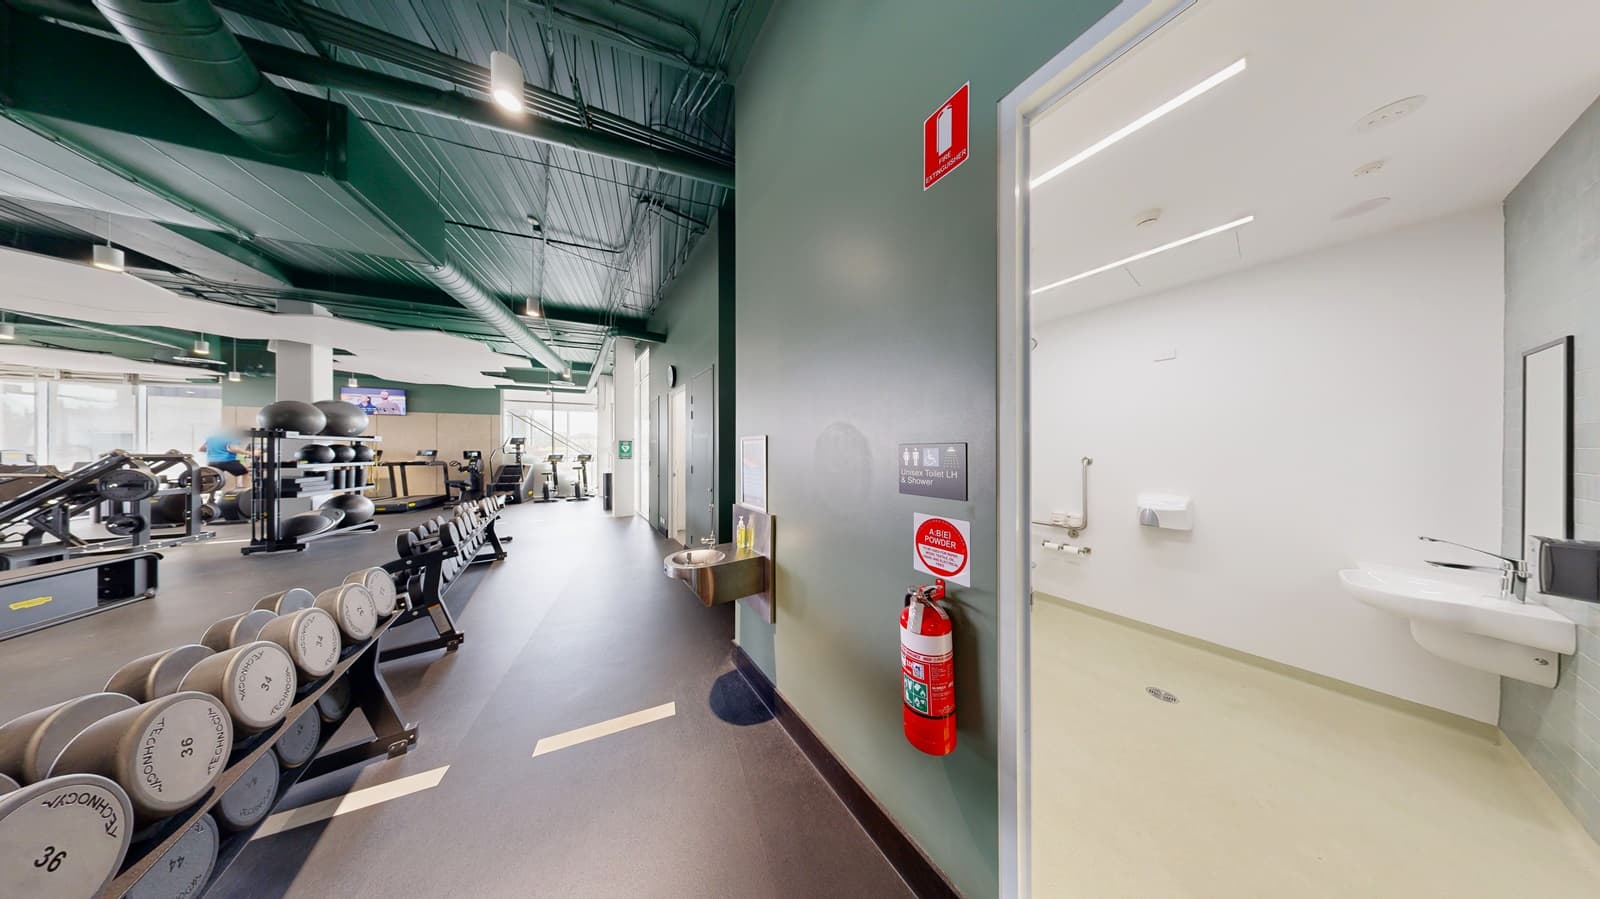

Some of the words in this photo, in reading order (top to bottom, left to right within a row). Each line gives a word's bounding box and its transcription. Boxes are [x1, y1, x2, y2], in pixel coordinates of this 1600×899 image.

[938, 149, 951, 164] FIRE
[901, 468, 923, 477] Unisex
[925, 469, 944, 479] Toilet
[945, 470, 958, 479] LH
[907, 476, 934, 487] Shower
[924, 534, 957, 550] POWDER
[261, 675, 272, 692] 34
[180, 737, 194, 758] 36
[33, 845, 67, 873] 36
